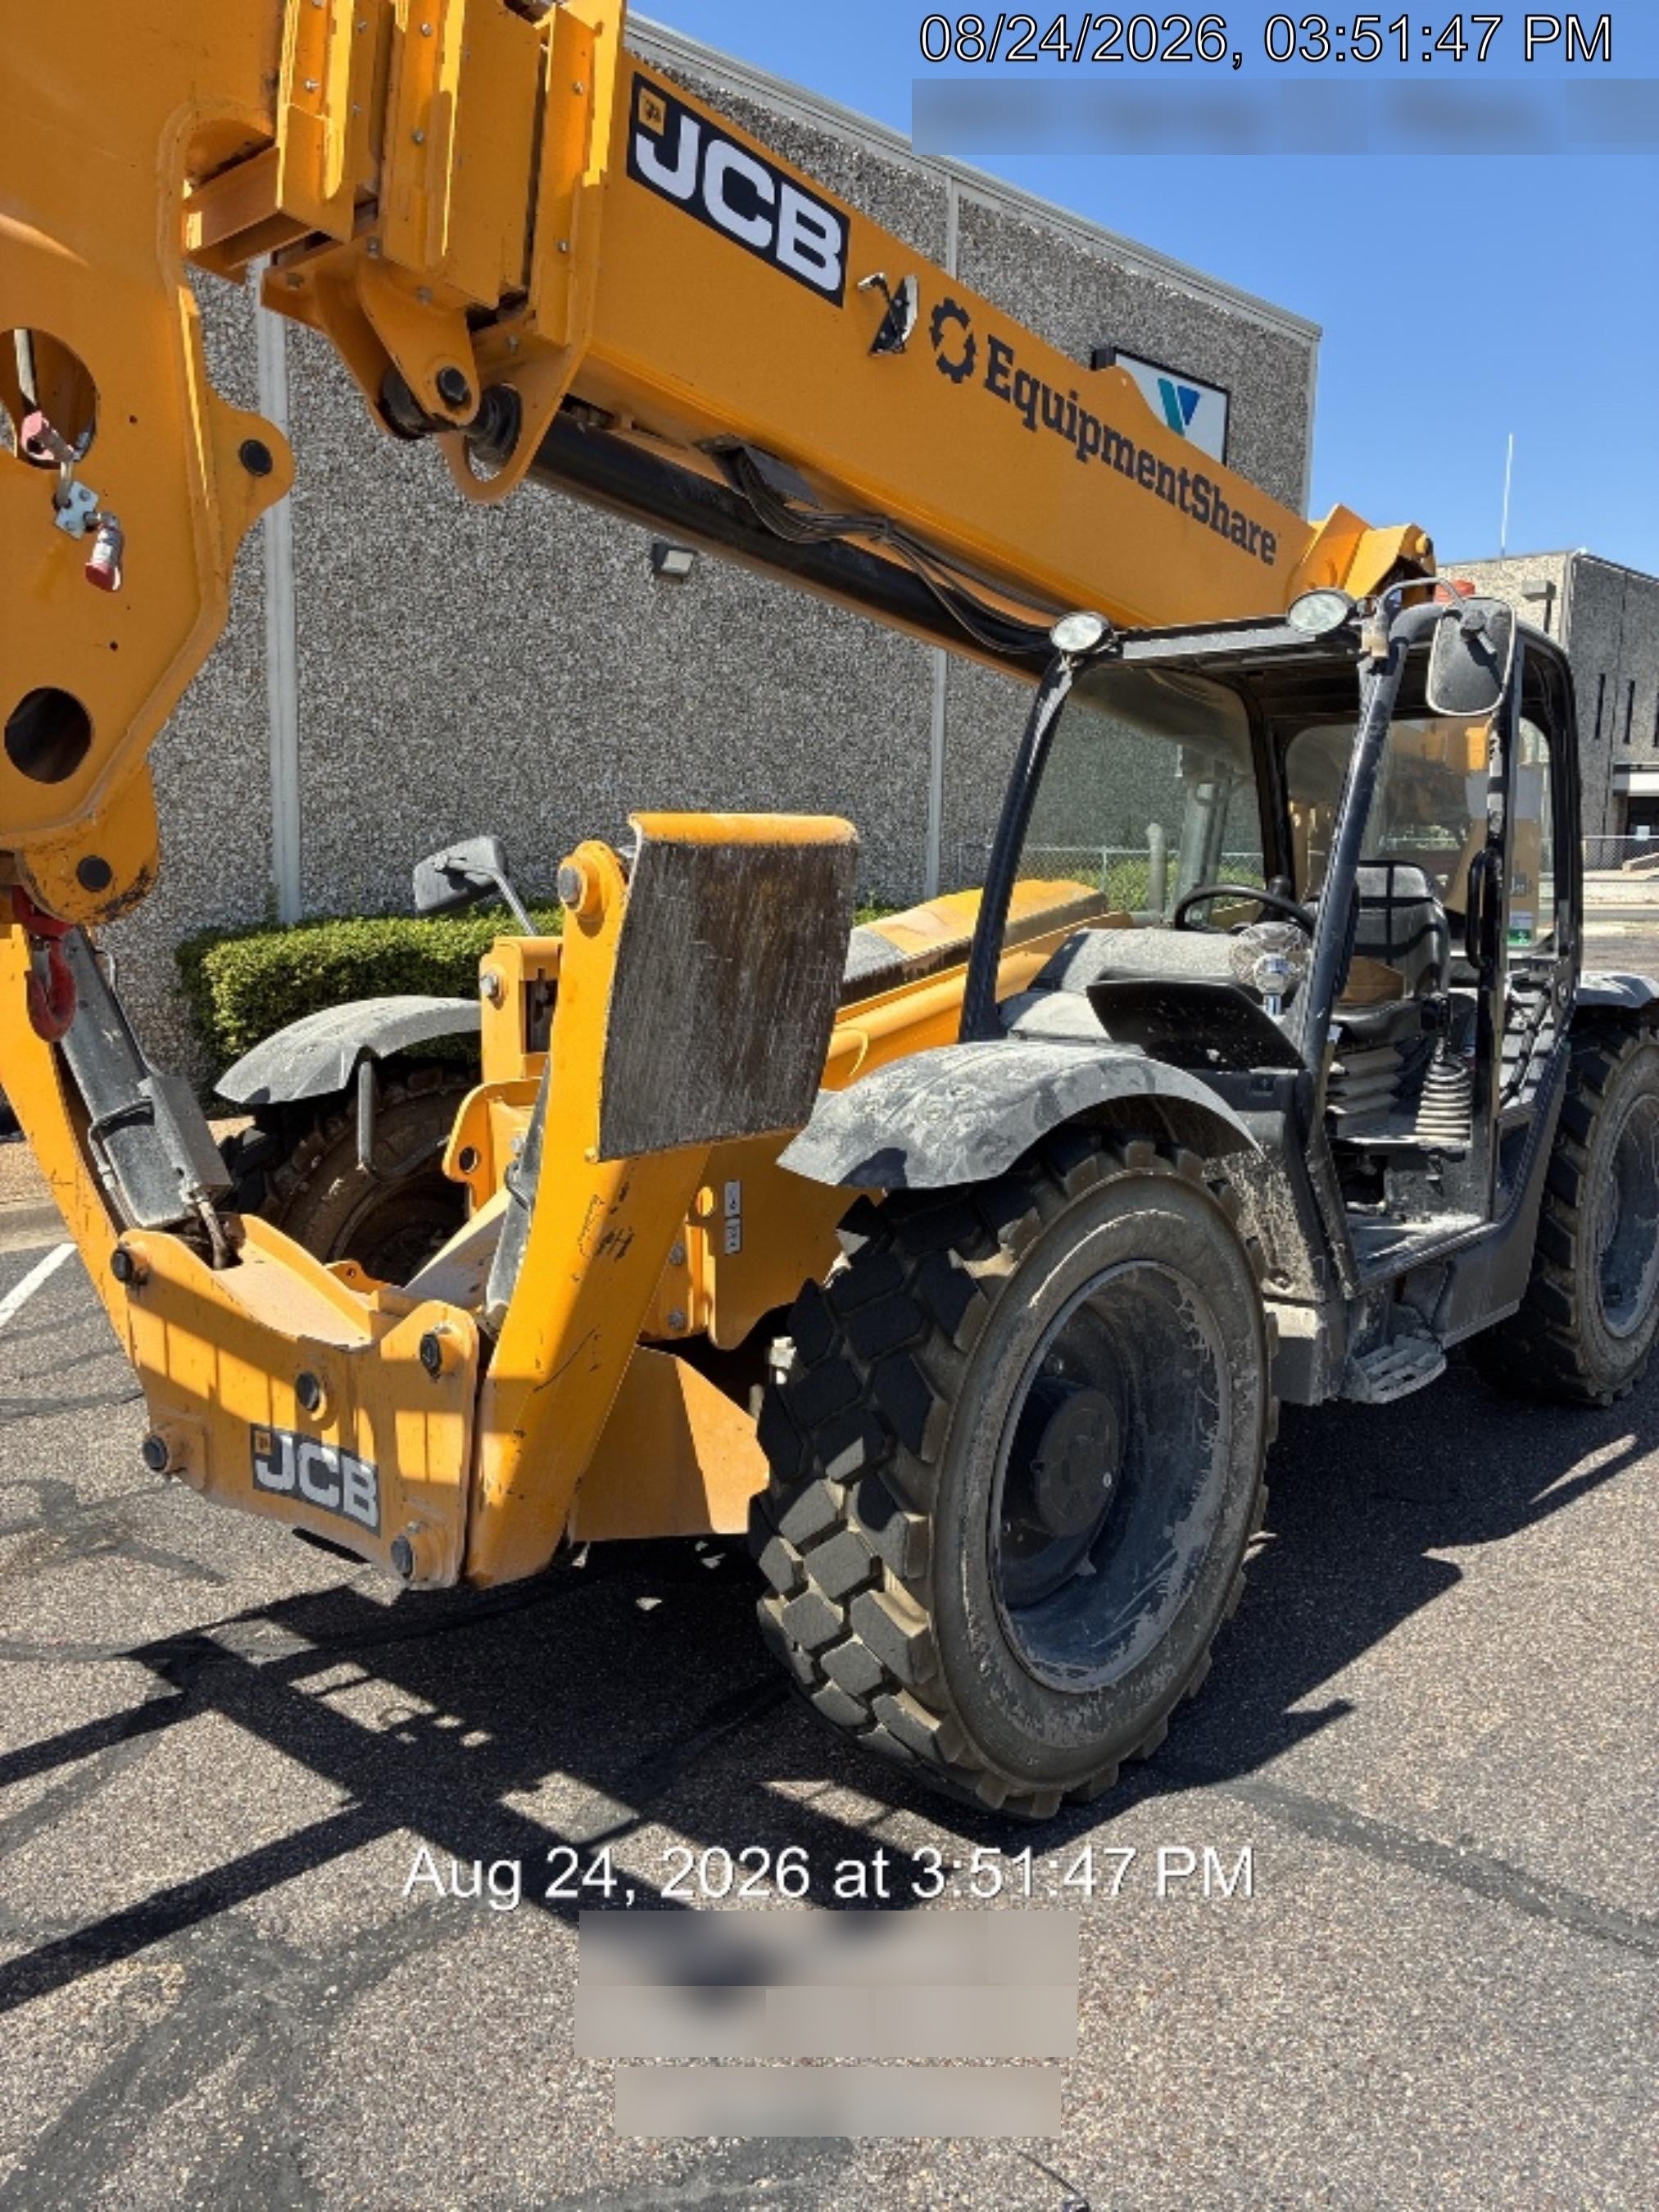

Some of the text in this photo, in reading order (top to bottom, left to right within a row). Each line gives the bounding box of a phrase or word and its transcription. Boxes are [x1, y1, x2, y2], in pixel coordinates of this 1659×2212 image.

[635, 114, 842, 292] JCB
[984, 333, 1277, 566] EquipmentShare
[255, 1435, 379, 1528] JCB
